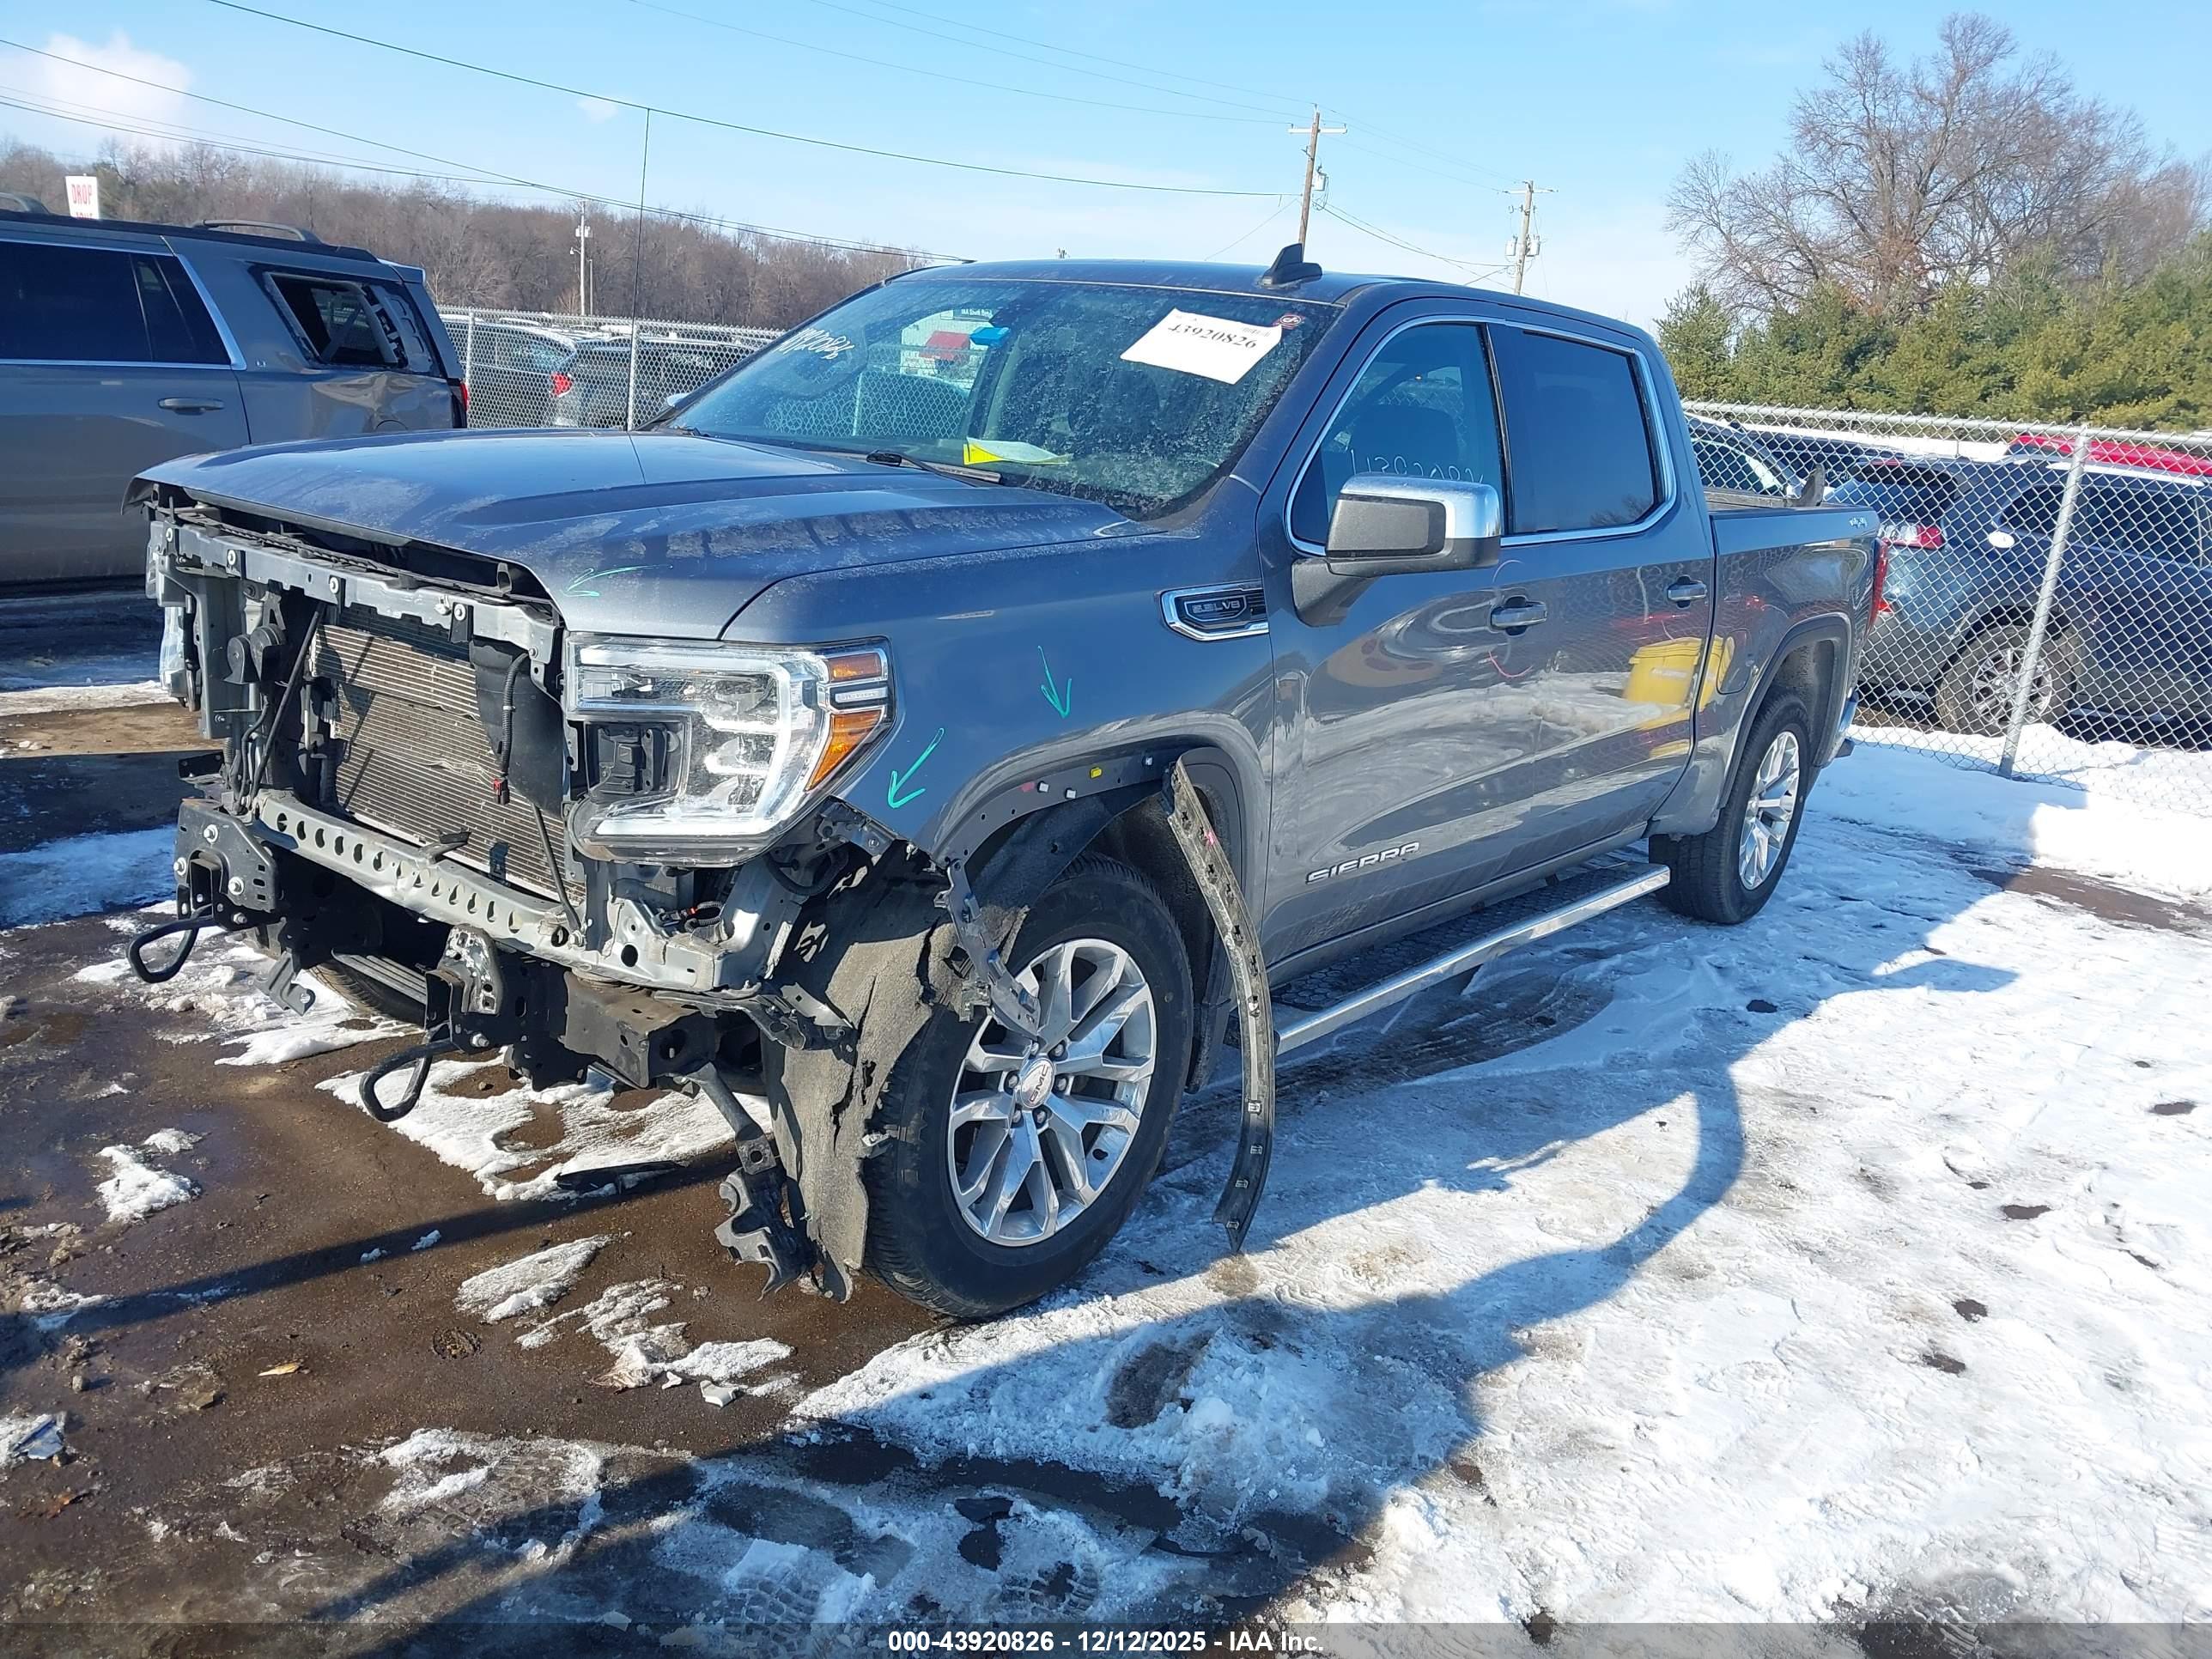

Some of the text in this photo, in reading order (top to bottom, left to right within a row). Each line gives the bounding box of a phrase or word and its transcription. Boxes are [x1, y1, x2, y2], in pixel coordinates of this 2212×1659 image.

[71, 184, 93, 205] DROP
[1168, 323, 1257, 349] 43920826
[1305, 842, 1419, 884] SIERRA
[1030, 1064, 1049, 1103] GMC
